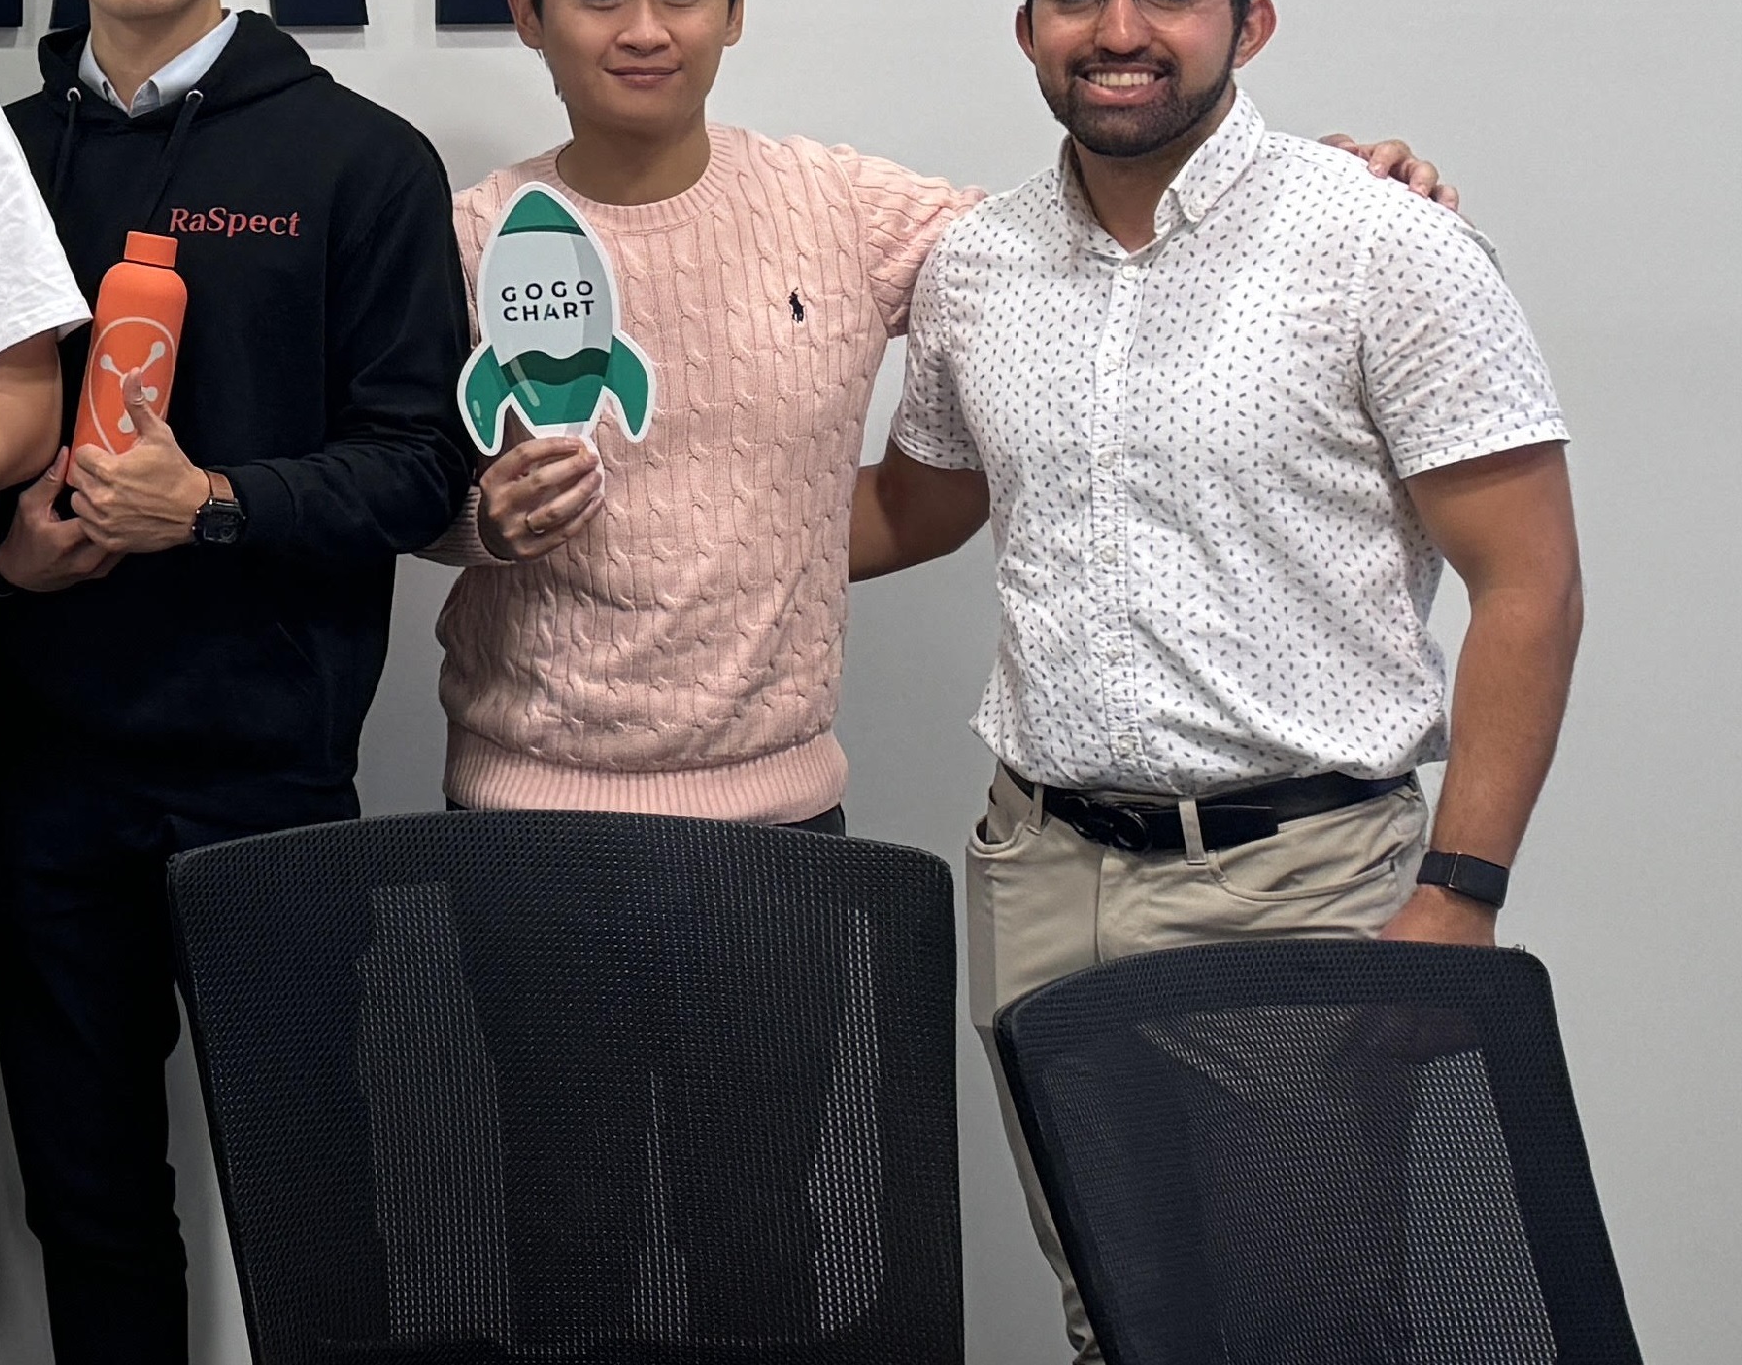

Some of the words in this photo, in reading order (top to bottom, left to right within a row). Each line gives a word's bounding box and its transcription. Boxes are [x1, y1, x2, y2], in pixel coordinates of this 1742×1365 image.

[169, 206, 301, 238] RaSpect
[501, 280, 593, 303] GOGO
[503, 300, 595, 322] CHART
